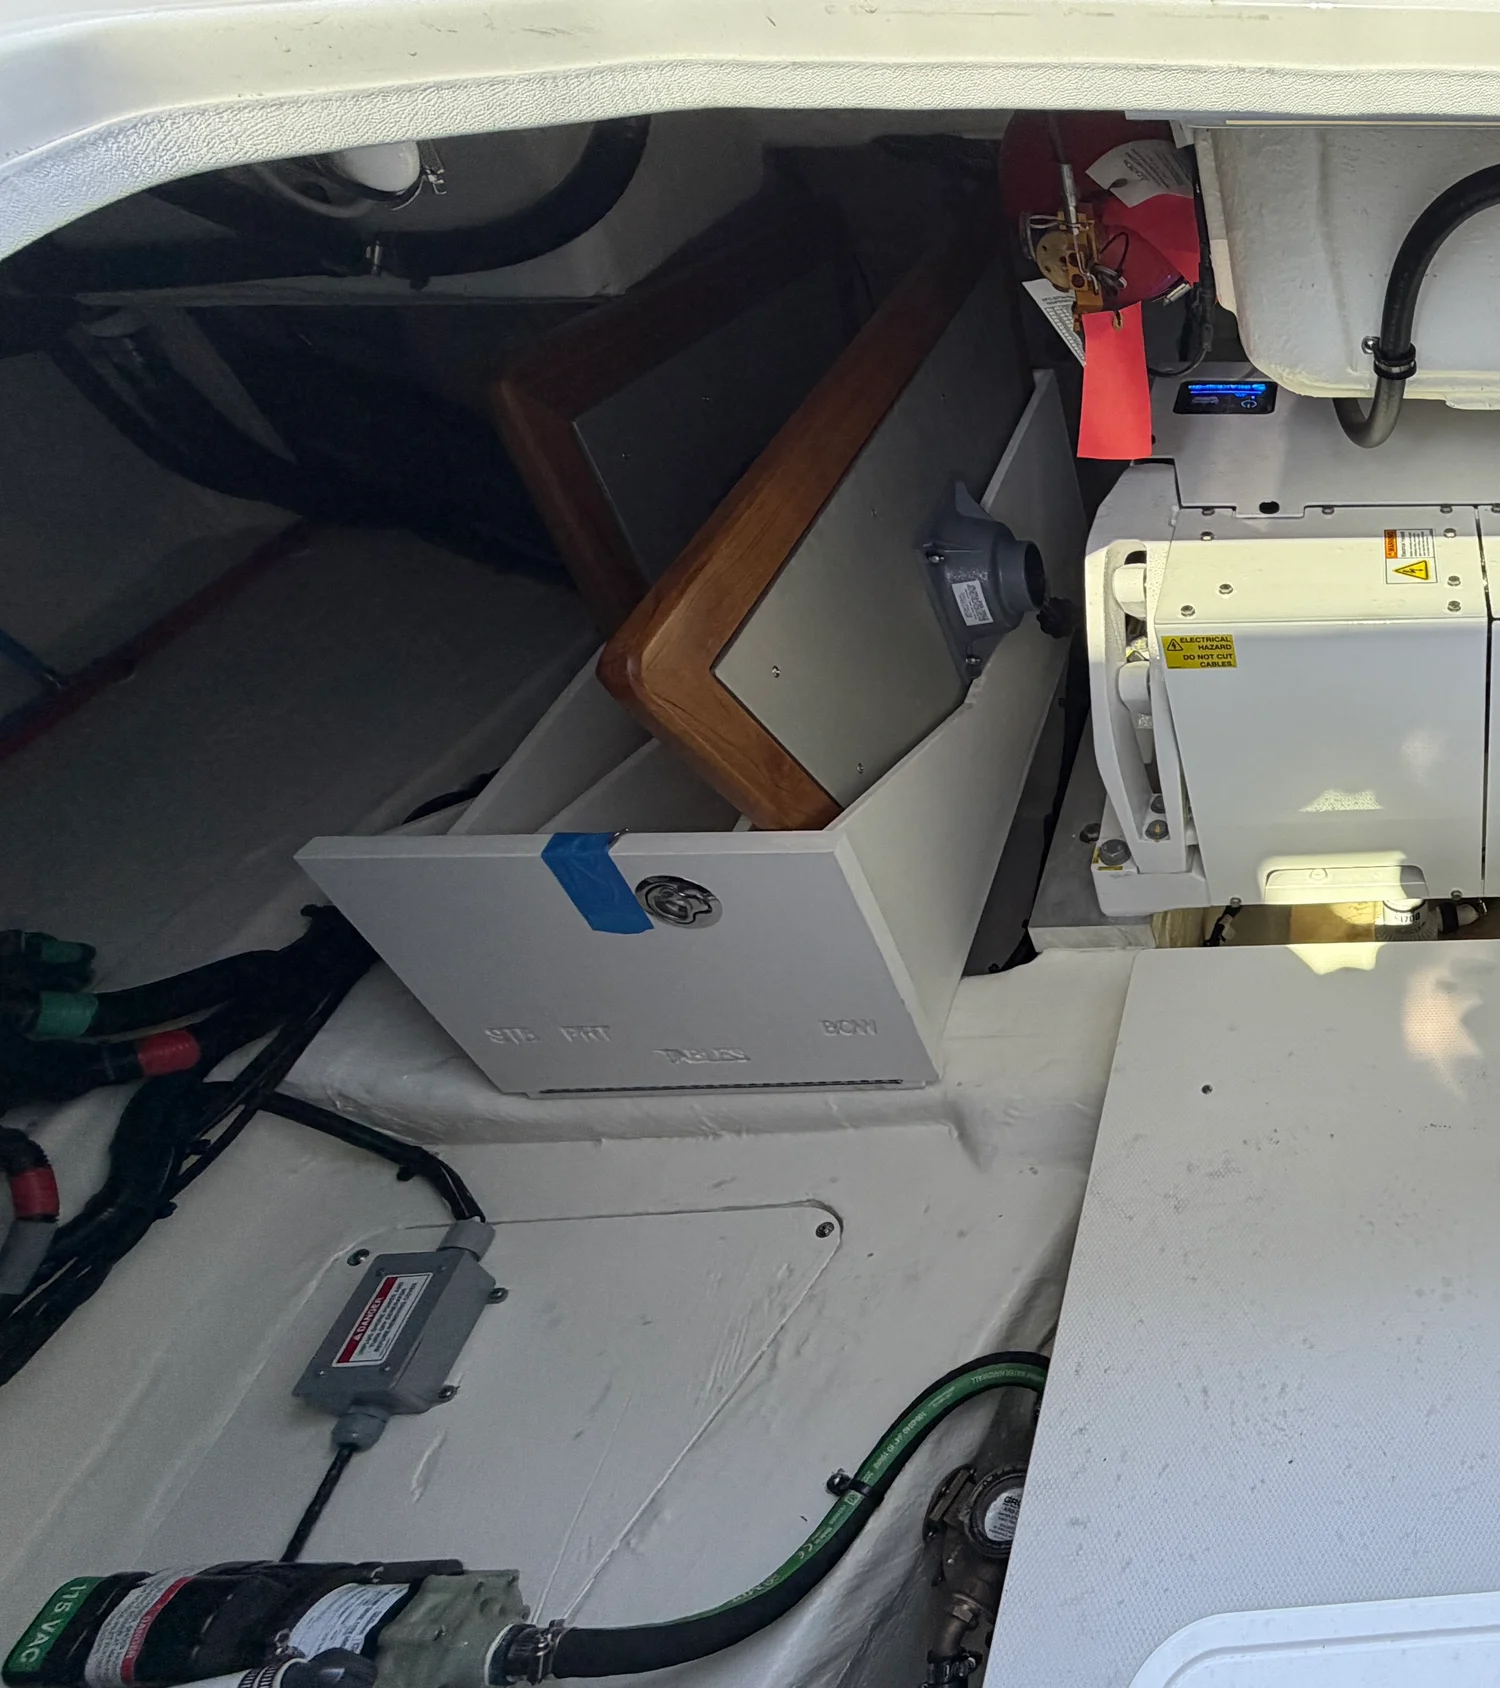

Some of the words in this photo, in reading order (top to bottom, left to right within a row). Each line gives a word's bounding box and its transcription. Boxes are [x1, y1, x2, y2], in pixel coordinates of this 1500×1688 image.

[356, 1296, 384, 1332] DANGER
[54, 1583, 87, 1613] 115
[20, 1618, 60, 1663] VAC
